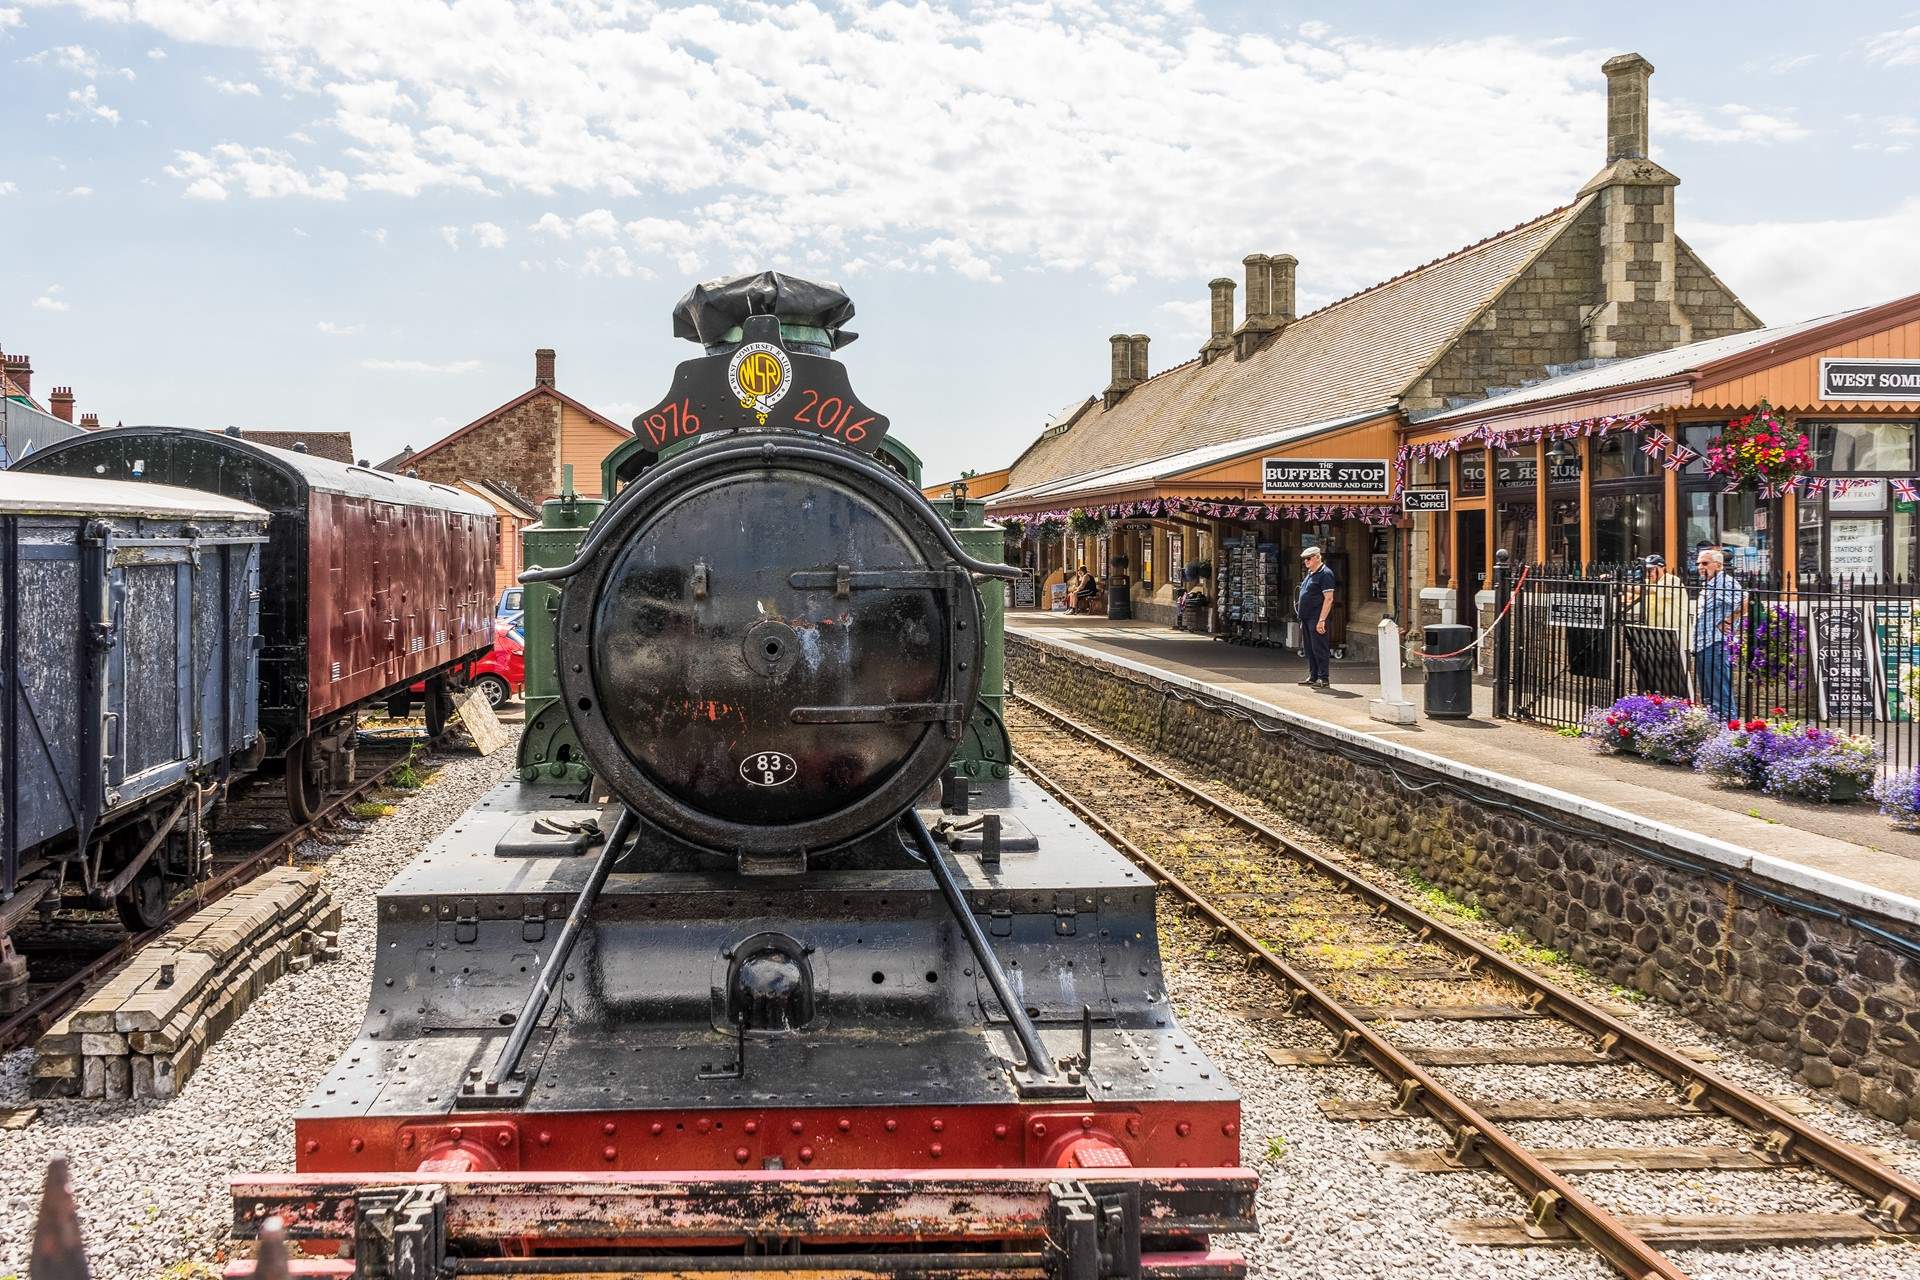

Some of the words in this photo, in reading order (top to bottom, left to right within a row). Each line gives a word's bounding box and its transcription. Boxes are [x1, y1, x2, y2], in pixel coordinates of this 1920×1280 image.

[729, 363, 737, 385] WEST
[736, 343, 774, 359] SOMERSET
[775, 350, 791, 385] RAILWAY
[739, 351, 782, 396] WSR
[1830, 373, 1876, 388] WEST
[642, 398, 700, 446] 1976
[793, 389, 876, 443] 2016
[1266, 468, 1332, 481] BUFFER
[1338, 469, 1385, 482] STOP
[1301, 481, 1343, 489] SOUVENIRS
[1420, 493, 1446, 501] TICKET
[1420, 501, 1446, 509] OFFICE
[757, 754, 781, 771] 83
[764, 770, 775, 785] B
